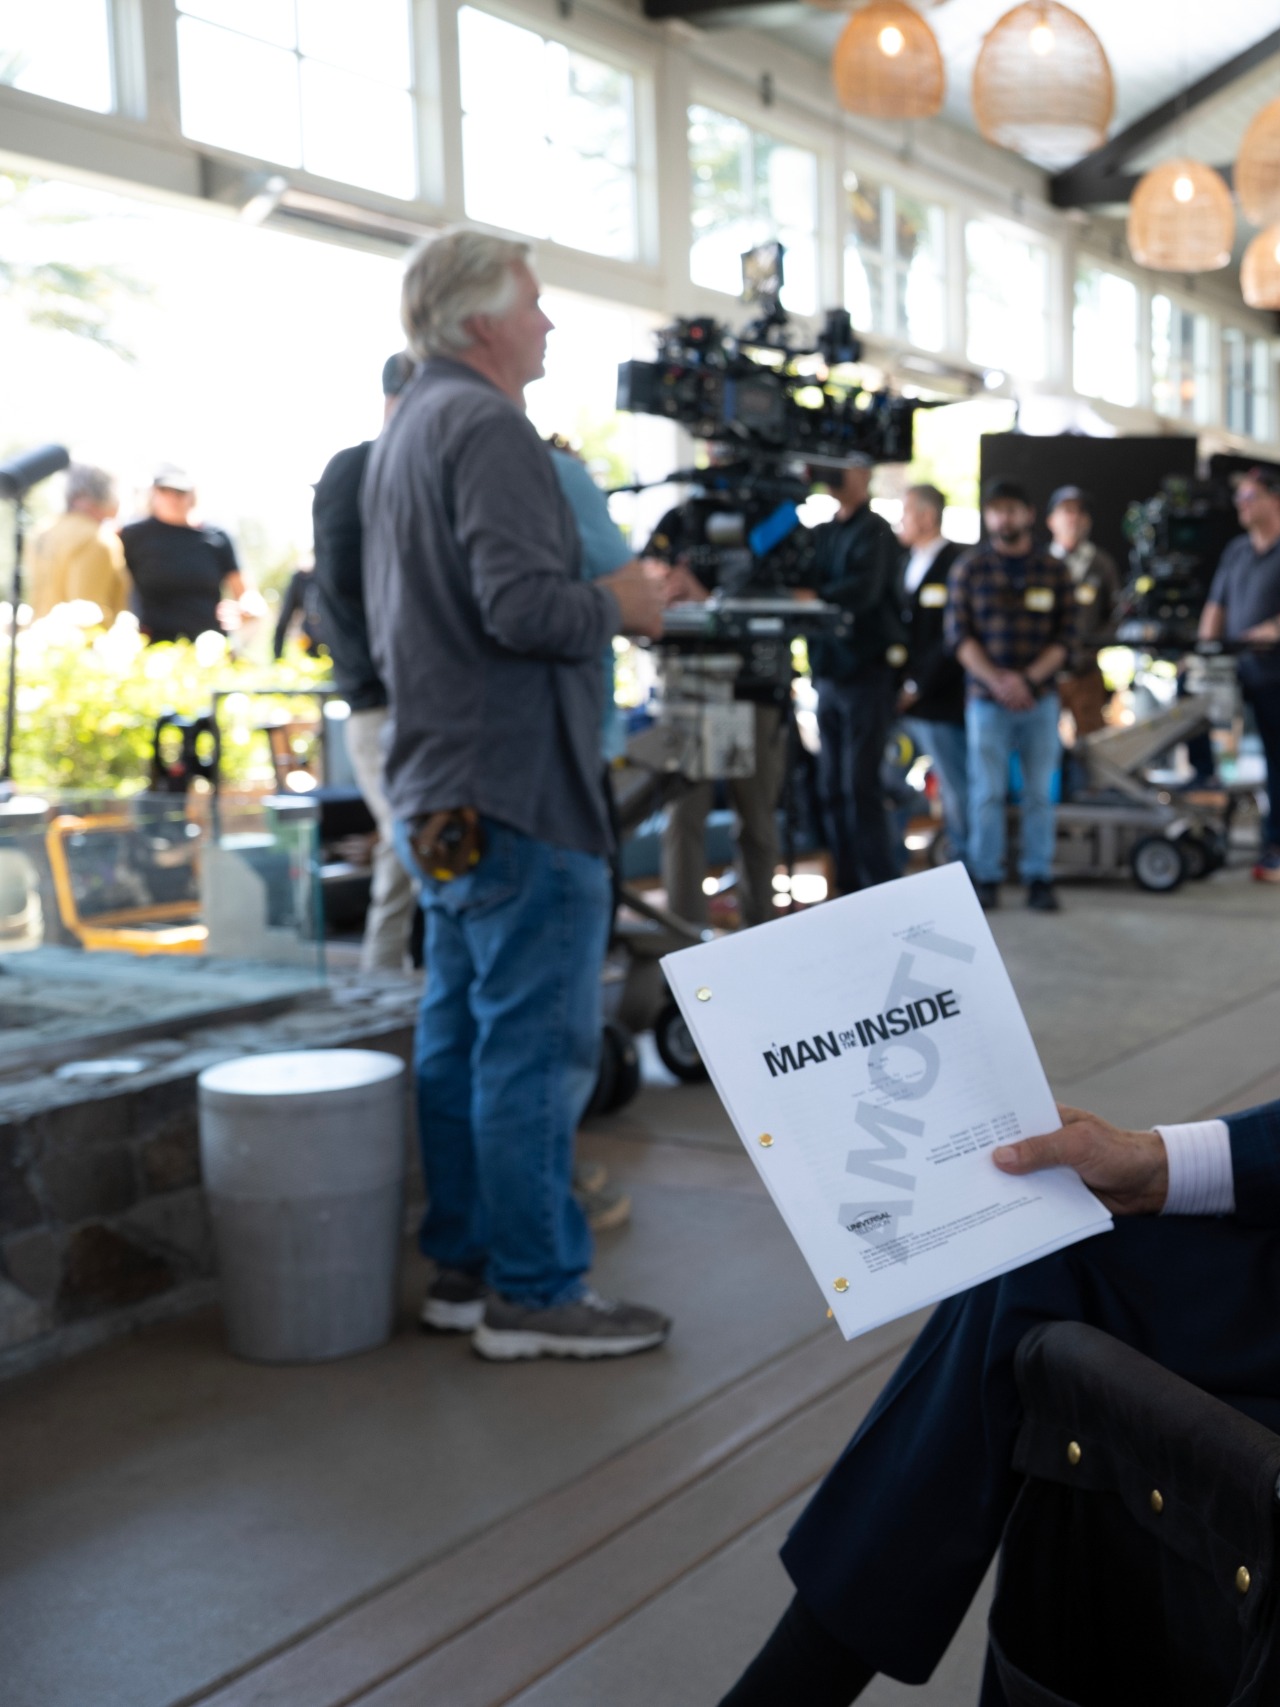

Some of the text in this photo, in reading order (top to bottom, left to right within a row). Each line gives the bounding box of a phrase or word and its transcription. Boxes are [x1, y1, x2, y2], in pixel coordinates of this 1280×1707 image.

[854, 989, 961, 1048] INSIDE
[838, 1029, 855, 1044] ON
[841, 1039, 860, 1050] THE
[762, 1030, 842, 1078] MAN
[846, 1211, 893, 1232] UNIVERSAL
